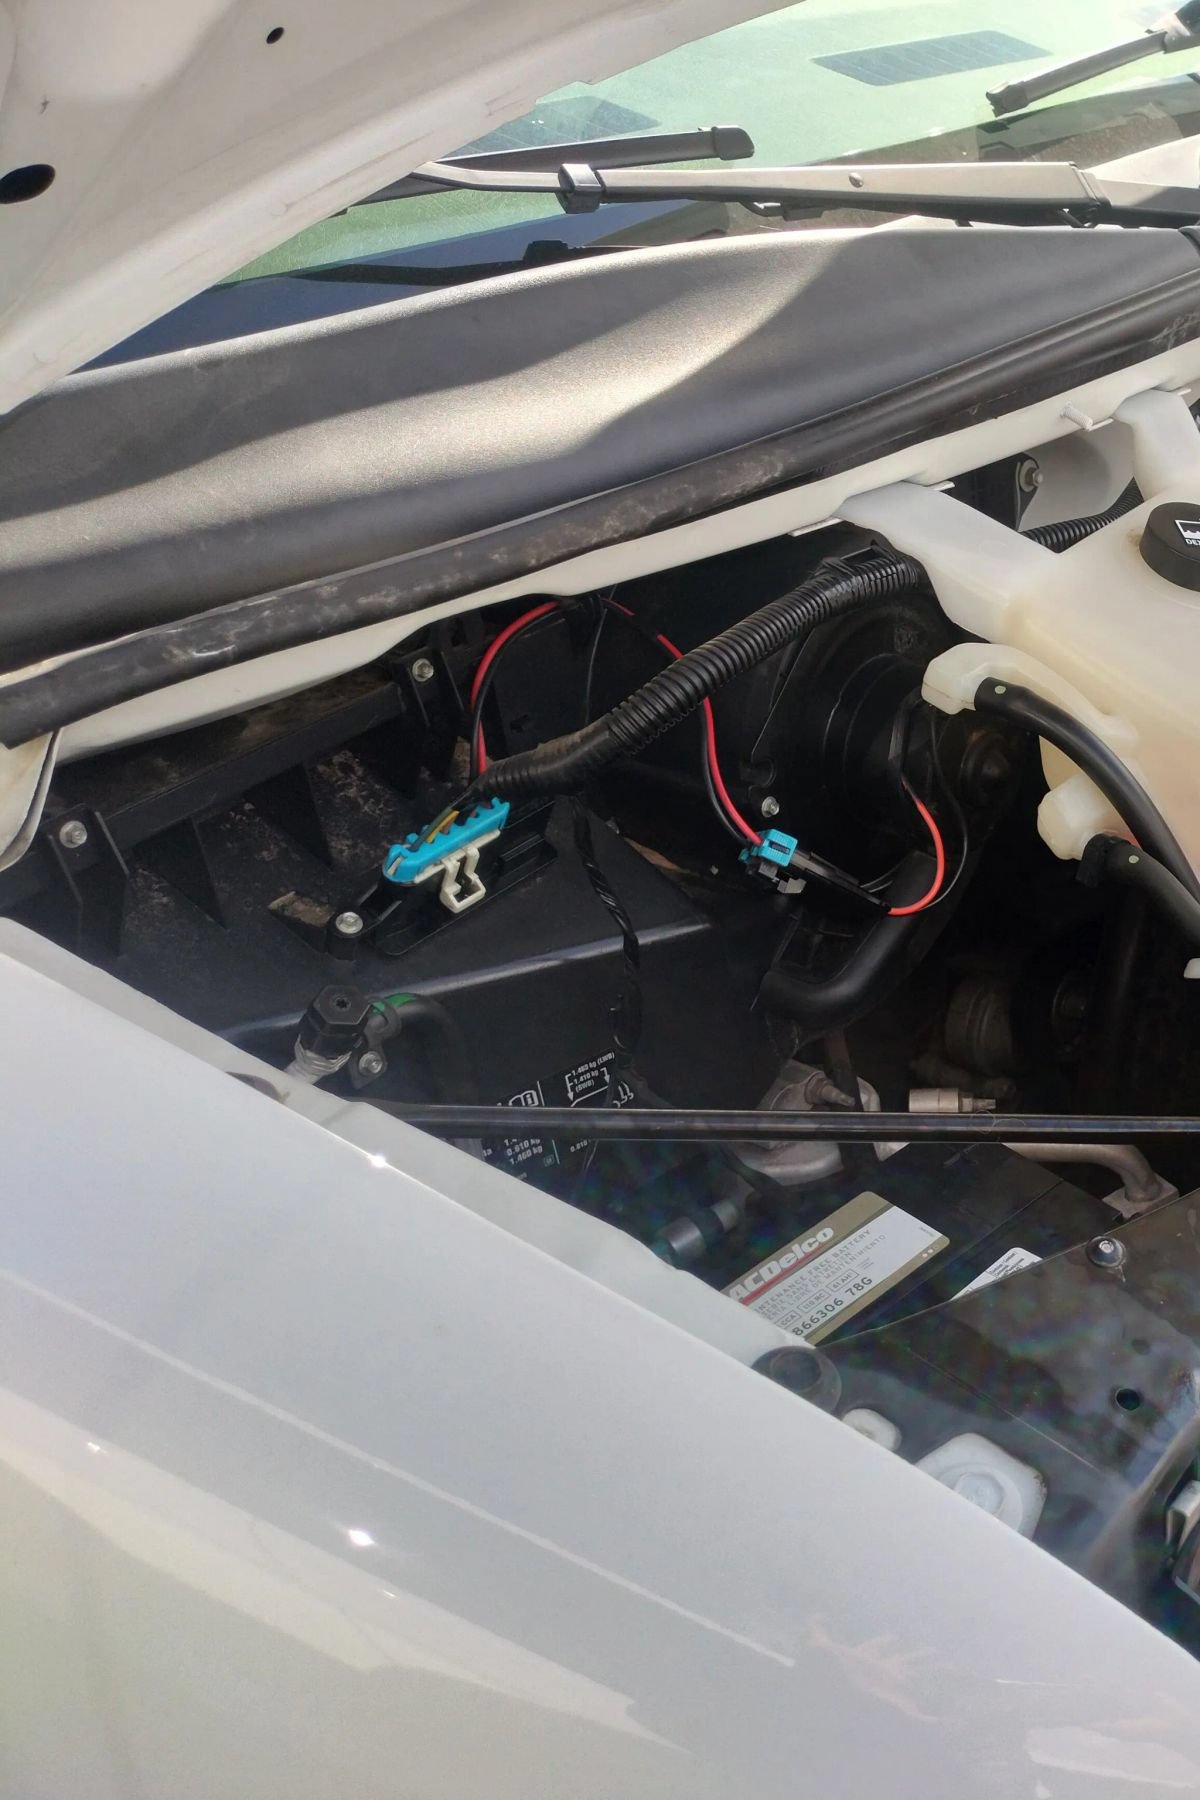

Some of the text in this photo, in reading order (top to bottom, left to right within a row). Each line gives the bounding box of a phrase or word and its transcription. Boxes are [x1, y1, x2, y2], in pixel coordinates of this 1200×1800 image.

[728, 1227, 835, 1299] ACDelco
[832, 1229, 871, 1258] BATTERY
[792, 1276, 873, 1337] 866306 78G
